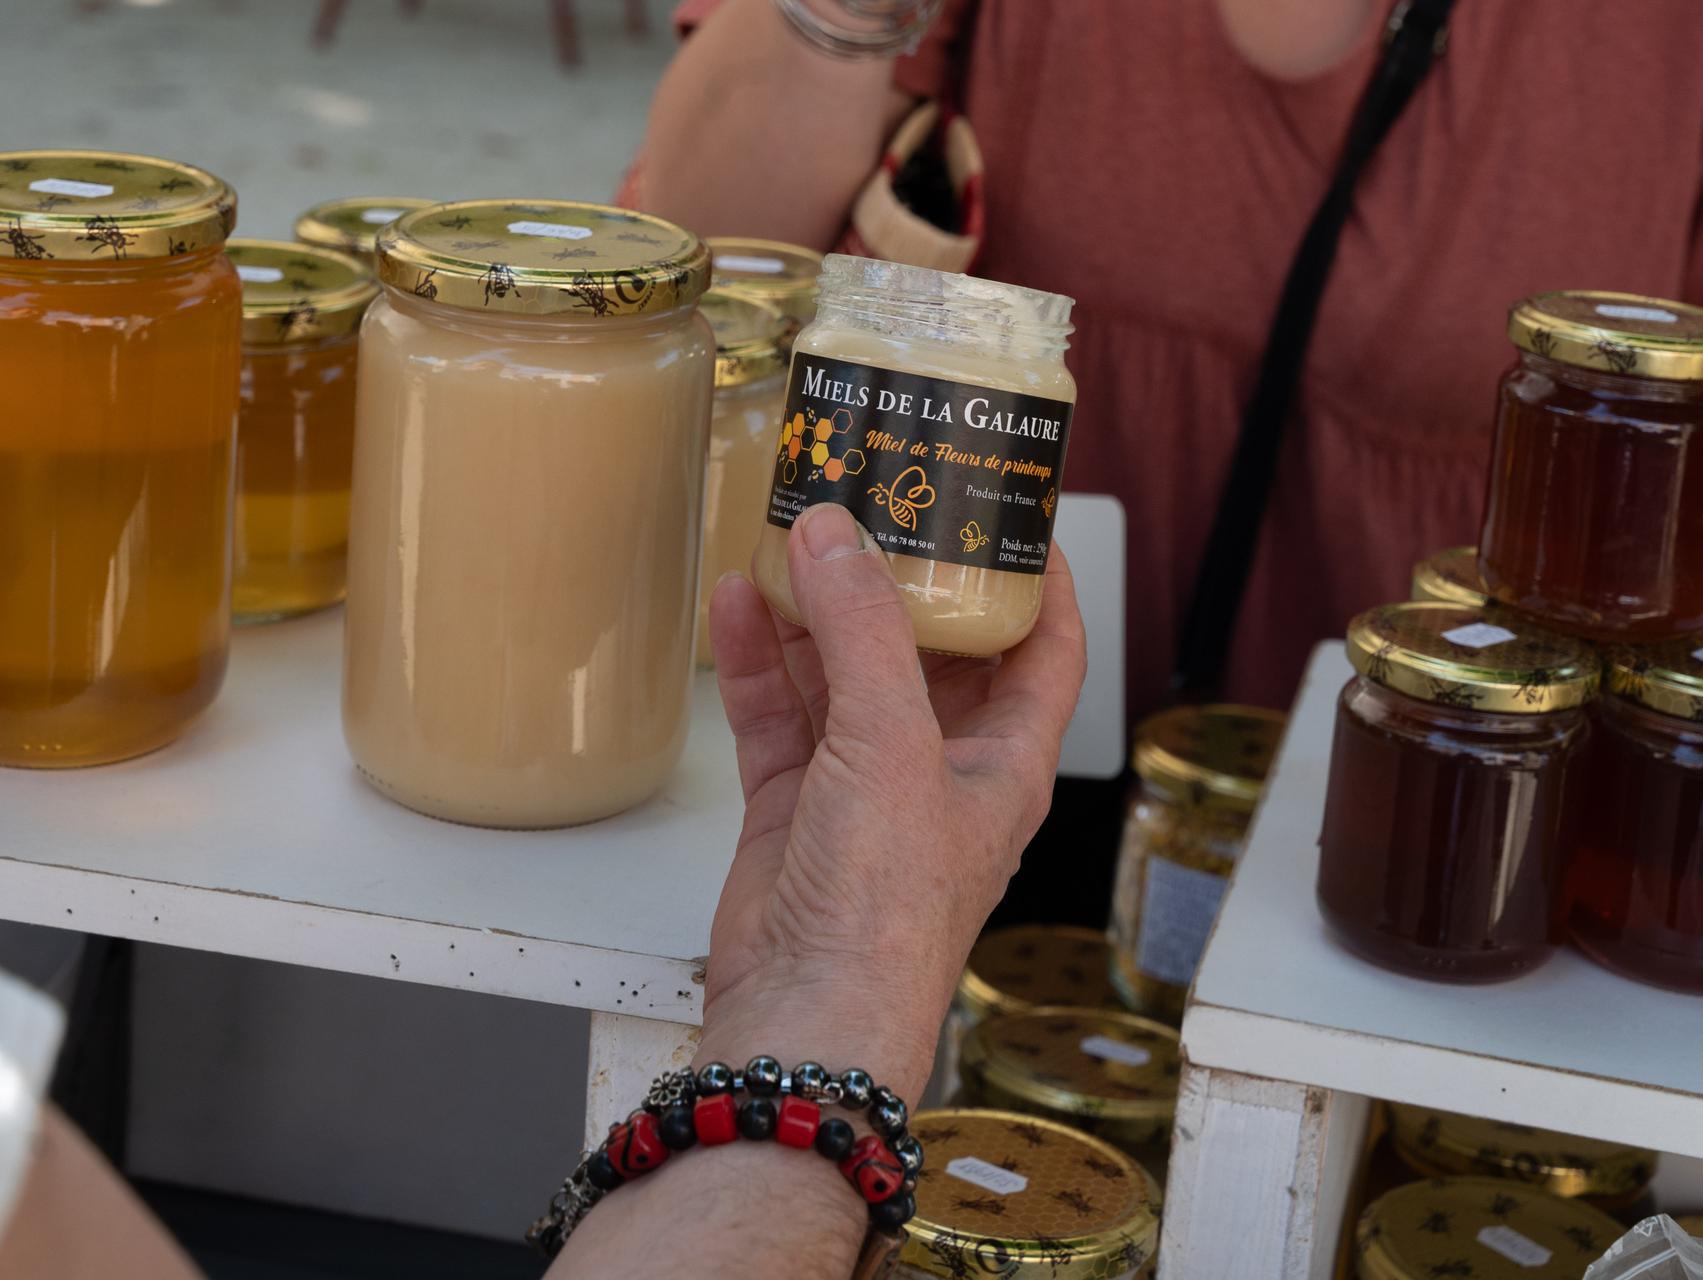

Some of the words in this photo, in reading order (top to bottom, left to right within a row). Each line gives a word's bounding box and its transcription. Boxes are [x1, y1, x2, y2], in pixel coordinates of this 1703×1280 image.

[802, 366, 870, 407] MIELS
[876, 389, 914, 416] DE
[920, 398, 954, 423] LA
[964, 397, 1061, 441] GALAURE
[866, 430, 905, 455] Miel
[910, 441, 929, 458] de
[935, 442, 980, 467] Fleurs
[985, 453, 1001, 471] de
[966, 484, 1000, 501] Produit
[1002, 493, 1012, 503] en
[1014, 492, 1037, 507] France
[889, 535, 898, 544] 06
[899, 537, 907, 545] 78
[908, 539, 917, 547] 08
[918, 541, 927, 549] 50
[1001, 538, 1021, 551] Poids
[1022, 544, 1033, 553] net
